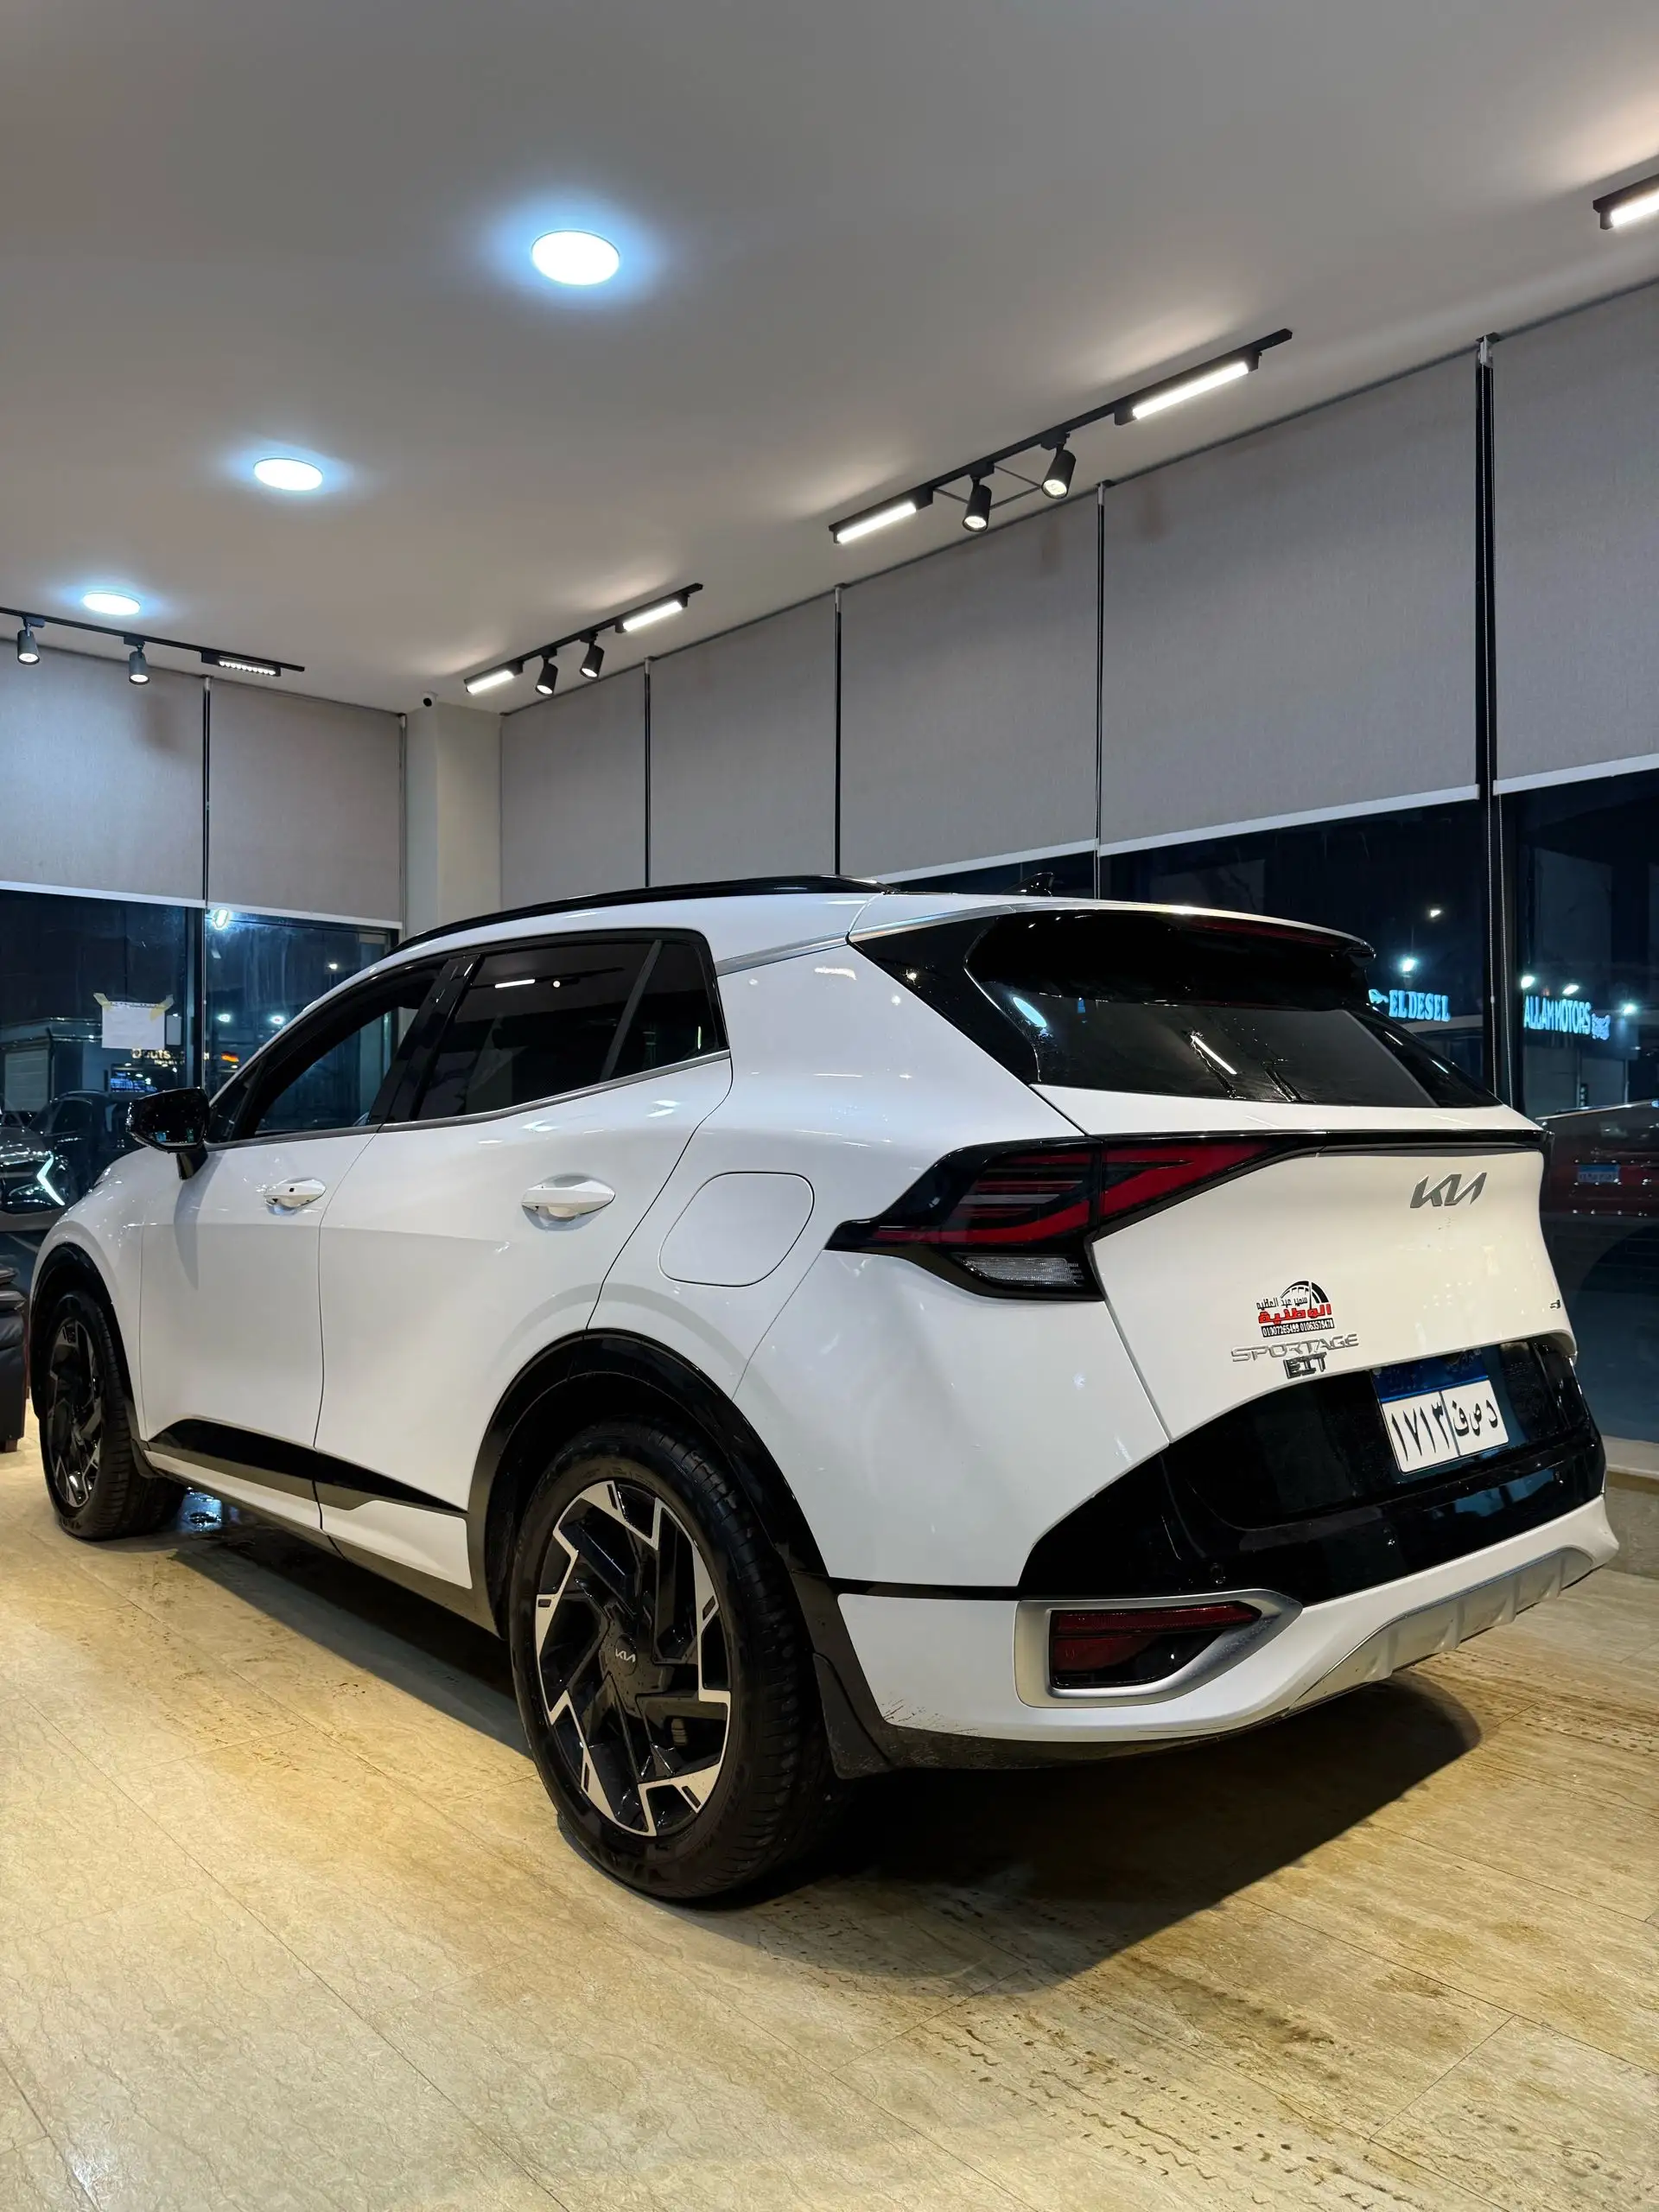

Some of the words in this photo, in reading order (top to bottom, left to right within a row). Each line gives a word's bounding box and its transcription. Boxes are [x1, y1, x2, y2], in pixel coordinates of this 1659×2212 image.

[1554, 998, 1591, 1034] MOTORS
[1258, 1303, 1332, 1325] الوطنية
[1281, 1298, 1292, 1309] عبد
[1231, 1333, 1359, 1363] SPORTAGE
